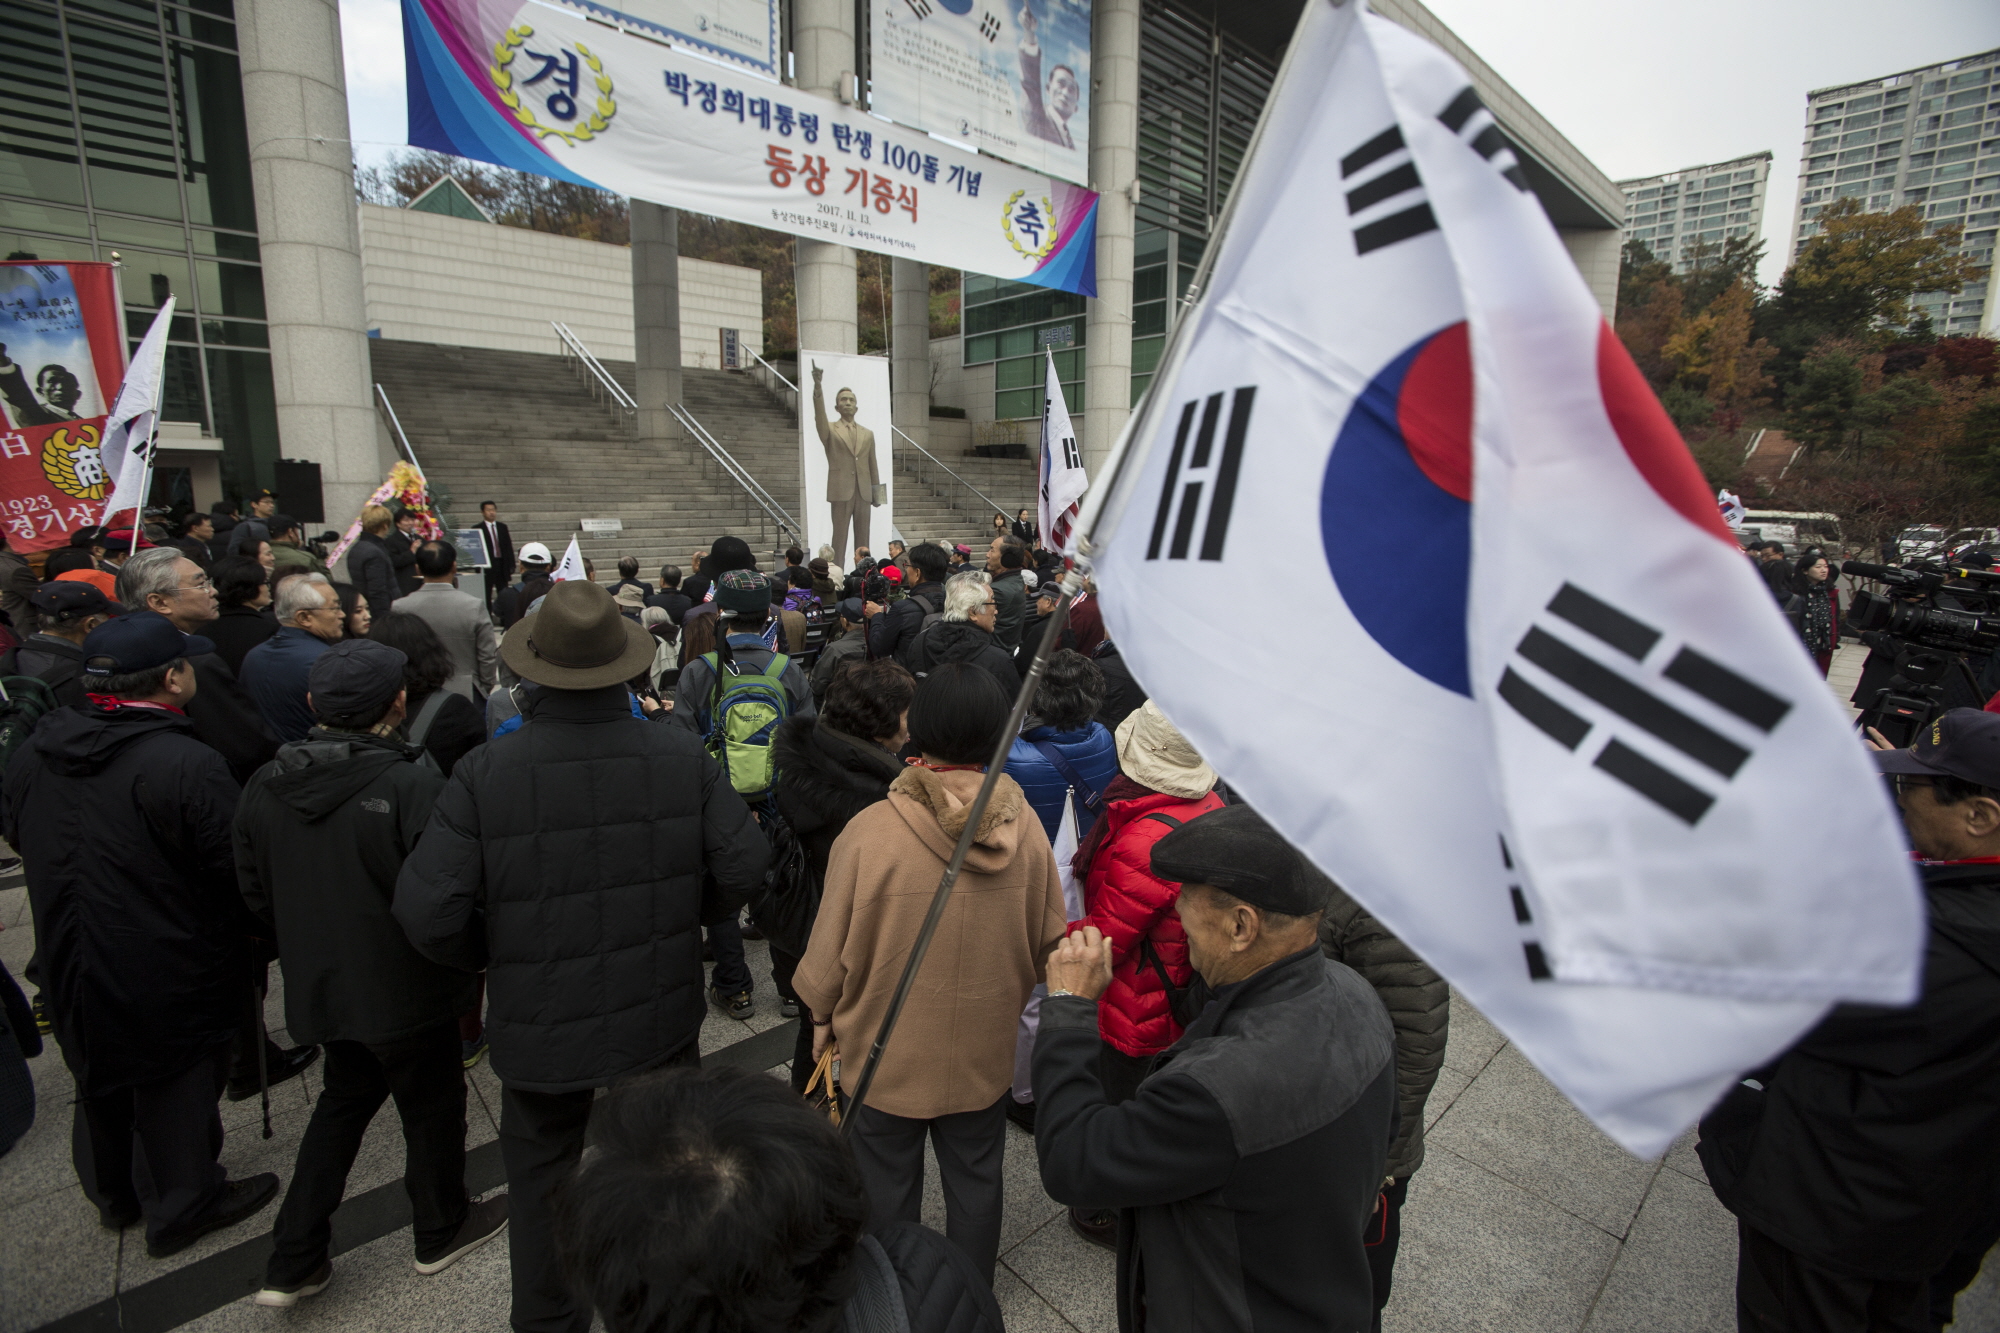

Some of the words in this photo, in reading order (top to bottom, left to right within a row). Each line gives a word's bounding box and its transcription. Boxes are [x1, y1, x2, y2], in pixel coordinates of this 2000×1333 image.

[521, 47, 579, 120] 경
[664, 69, 819, 142] 박정희대통령
[831, 121, 873, 158] 탄생
[882, 140, 940, 184] 100돌
[946, 164, 982, 197] 기념
[765, 143, 830, 195] 동상
[845, 166, 918, 224] 기증식
[771, 209, 838, 232] 동상건립추진모임
[817, 203, 843, 218] 2017.
[1014, 200, 1045, 248] 축
[0, 495, 52, 516] 1923
[7, 494, 112, 539] 경기상
